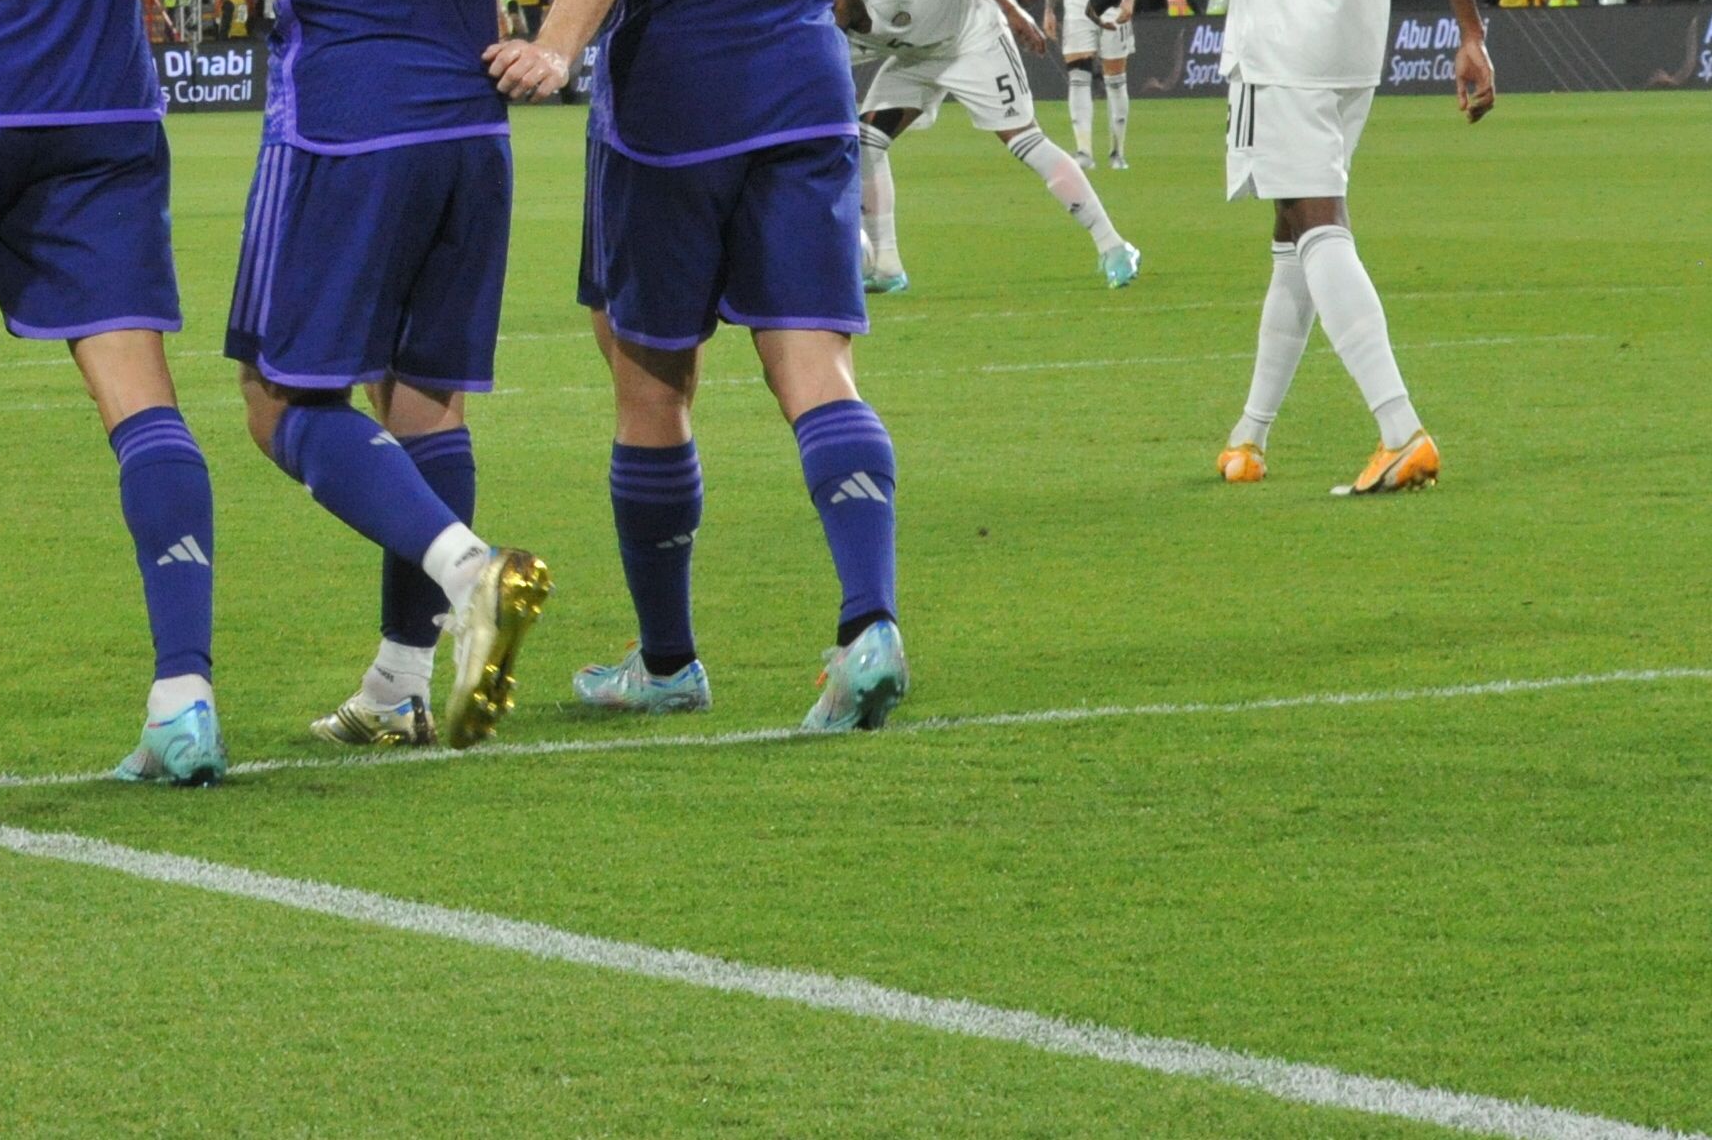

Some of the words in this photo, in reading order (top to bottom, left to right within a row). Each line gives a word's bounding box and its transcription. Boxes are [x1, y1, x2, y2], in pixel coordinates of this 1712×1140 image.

[1190, 24, 1224, 54] Abu
[1394, 19, 1433, 50] Abu
[1434, 17, 1490, 49] Dhi
[164, 48, 253, 78] Dhabi
[1388, 54, 1432, 86] Sports
[174, 79, 252, 103] Council
[995, 74, 1016, 105] 5
